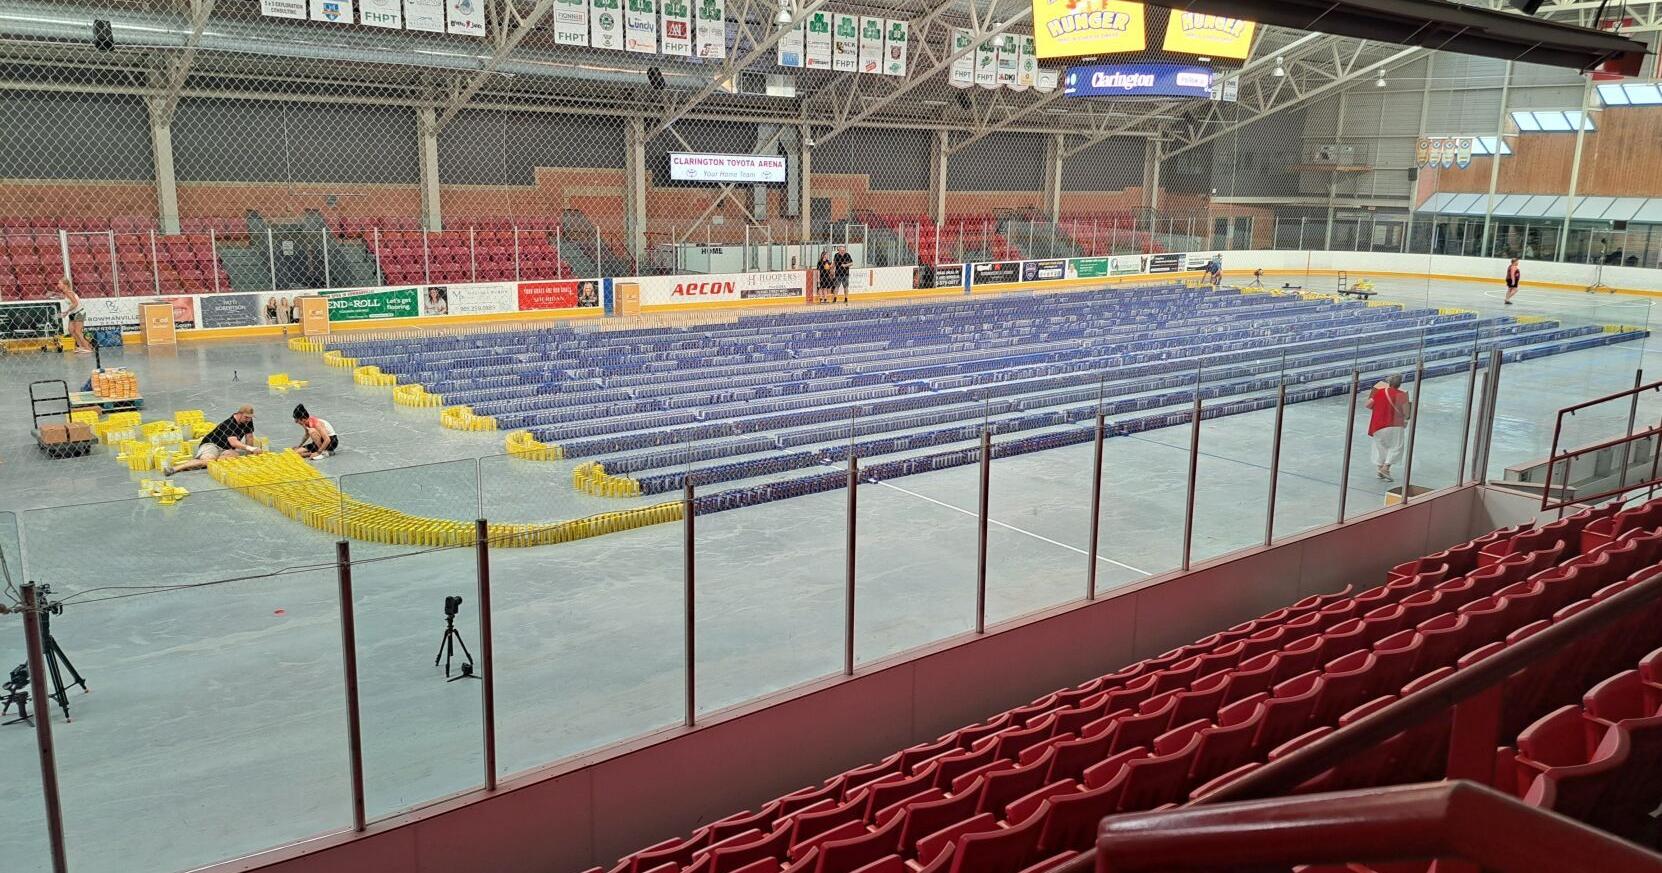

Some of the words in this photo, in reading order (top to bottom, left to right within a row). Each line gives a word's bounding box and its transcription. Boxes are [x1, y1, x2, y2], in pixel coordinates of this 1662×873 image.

[365, 12, 398, 24] FHPT
[628, 17, 654, 33] Lundy
[1047, 11, 1130, 38] HUNGER
[558, 32, 585, 42] FHPT
[665, 42, 689, 52] FHPT
[835, 59, 855, 68] FHPT
[954, 70, 971, 79] FHPT
[976, 73, 993, 81] FHPT
[1092, 72, 1155, 90] Clarington
[674, 157, 725, 166] CLARINGTON
[727, 159, 755, 167] TOYOTA
[758, 160, 783, 168] ARENA
[701, 247, 724, 255] HOME
[353, 299, 380, 308] ROLL
